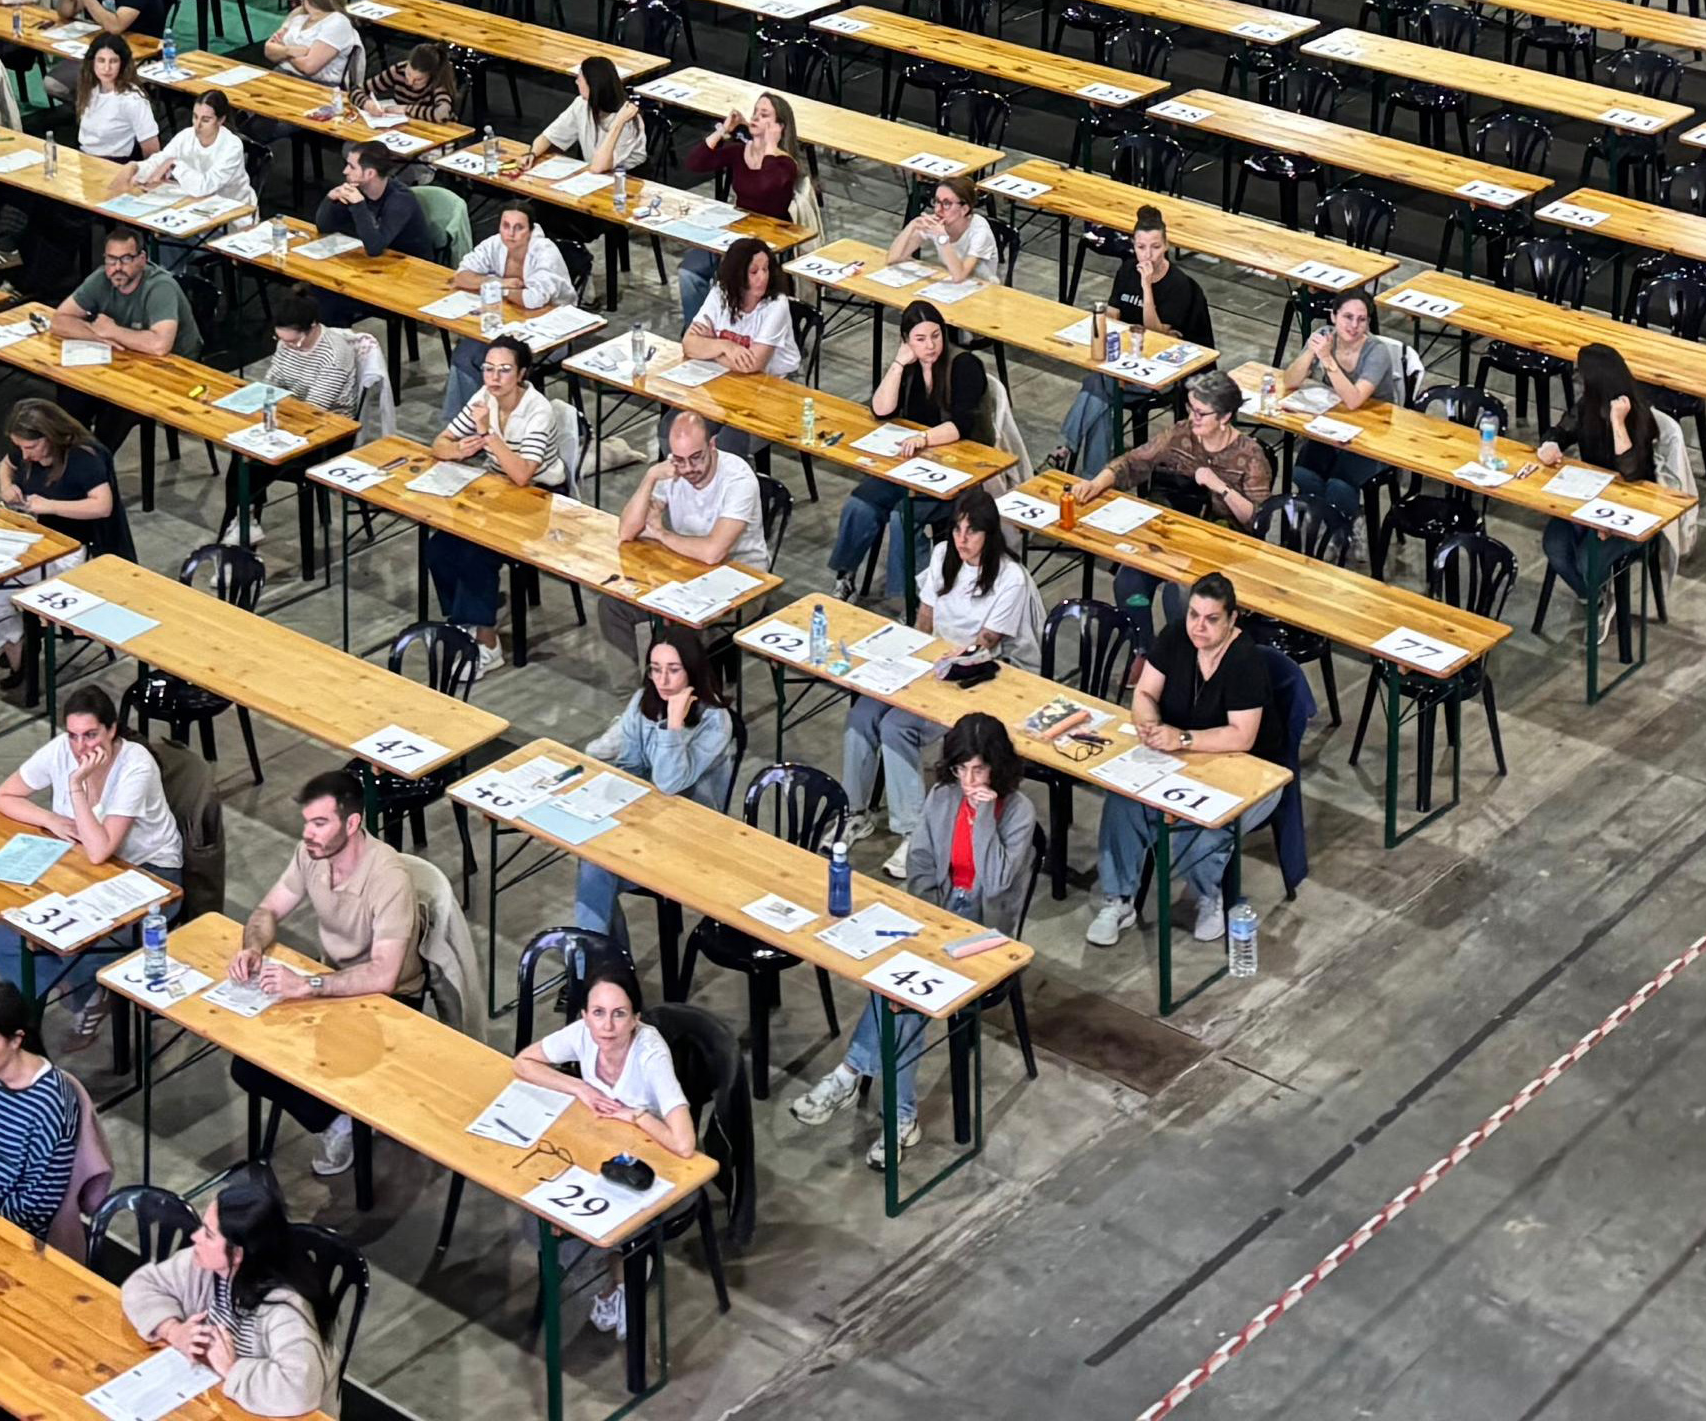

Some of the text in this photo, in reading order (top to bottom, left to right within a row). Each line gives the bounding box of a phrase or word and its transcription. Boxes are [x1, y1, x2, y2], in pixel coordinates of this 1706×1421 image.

[994, 179, 1037, 195] 112
[1466, 185, 1514, 198] 127
[1550, 207, 1594, 222] 126
[806, 262, 834, 276] 96
[1299, 266, 1346, 283] 111
[1398, 295, 1449, 314] 110
[1115, 361, 1156, 377] 95
[328, 468, 367, 483] 64
[907, 467, 947, 482] 79
[1003, 500, 1045, 519] 78
[1594, 508, 1635, 526] 93
[37, 592, 78, 610] 48
[761, 633, 804, 652] 62
[1394, 638, 1443, 658] 77
[376, 740, 424, 759] 47
[1163, 789, 1210, 809] 61
[26, 908, 80, 935] 31
[890, 970, 944, 996] 45
[547, 1185, 610, 1216] 29
